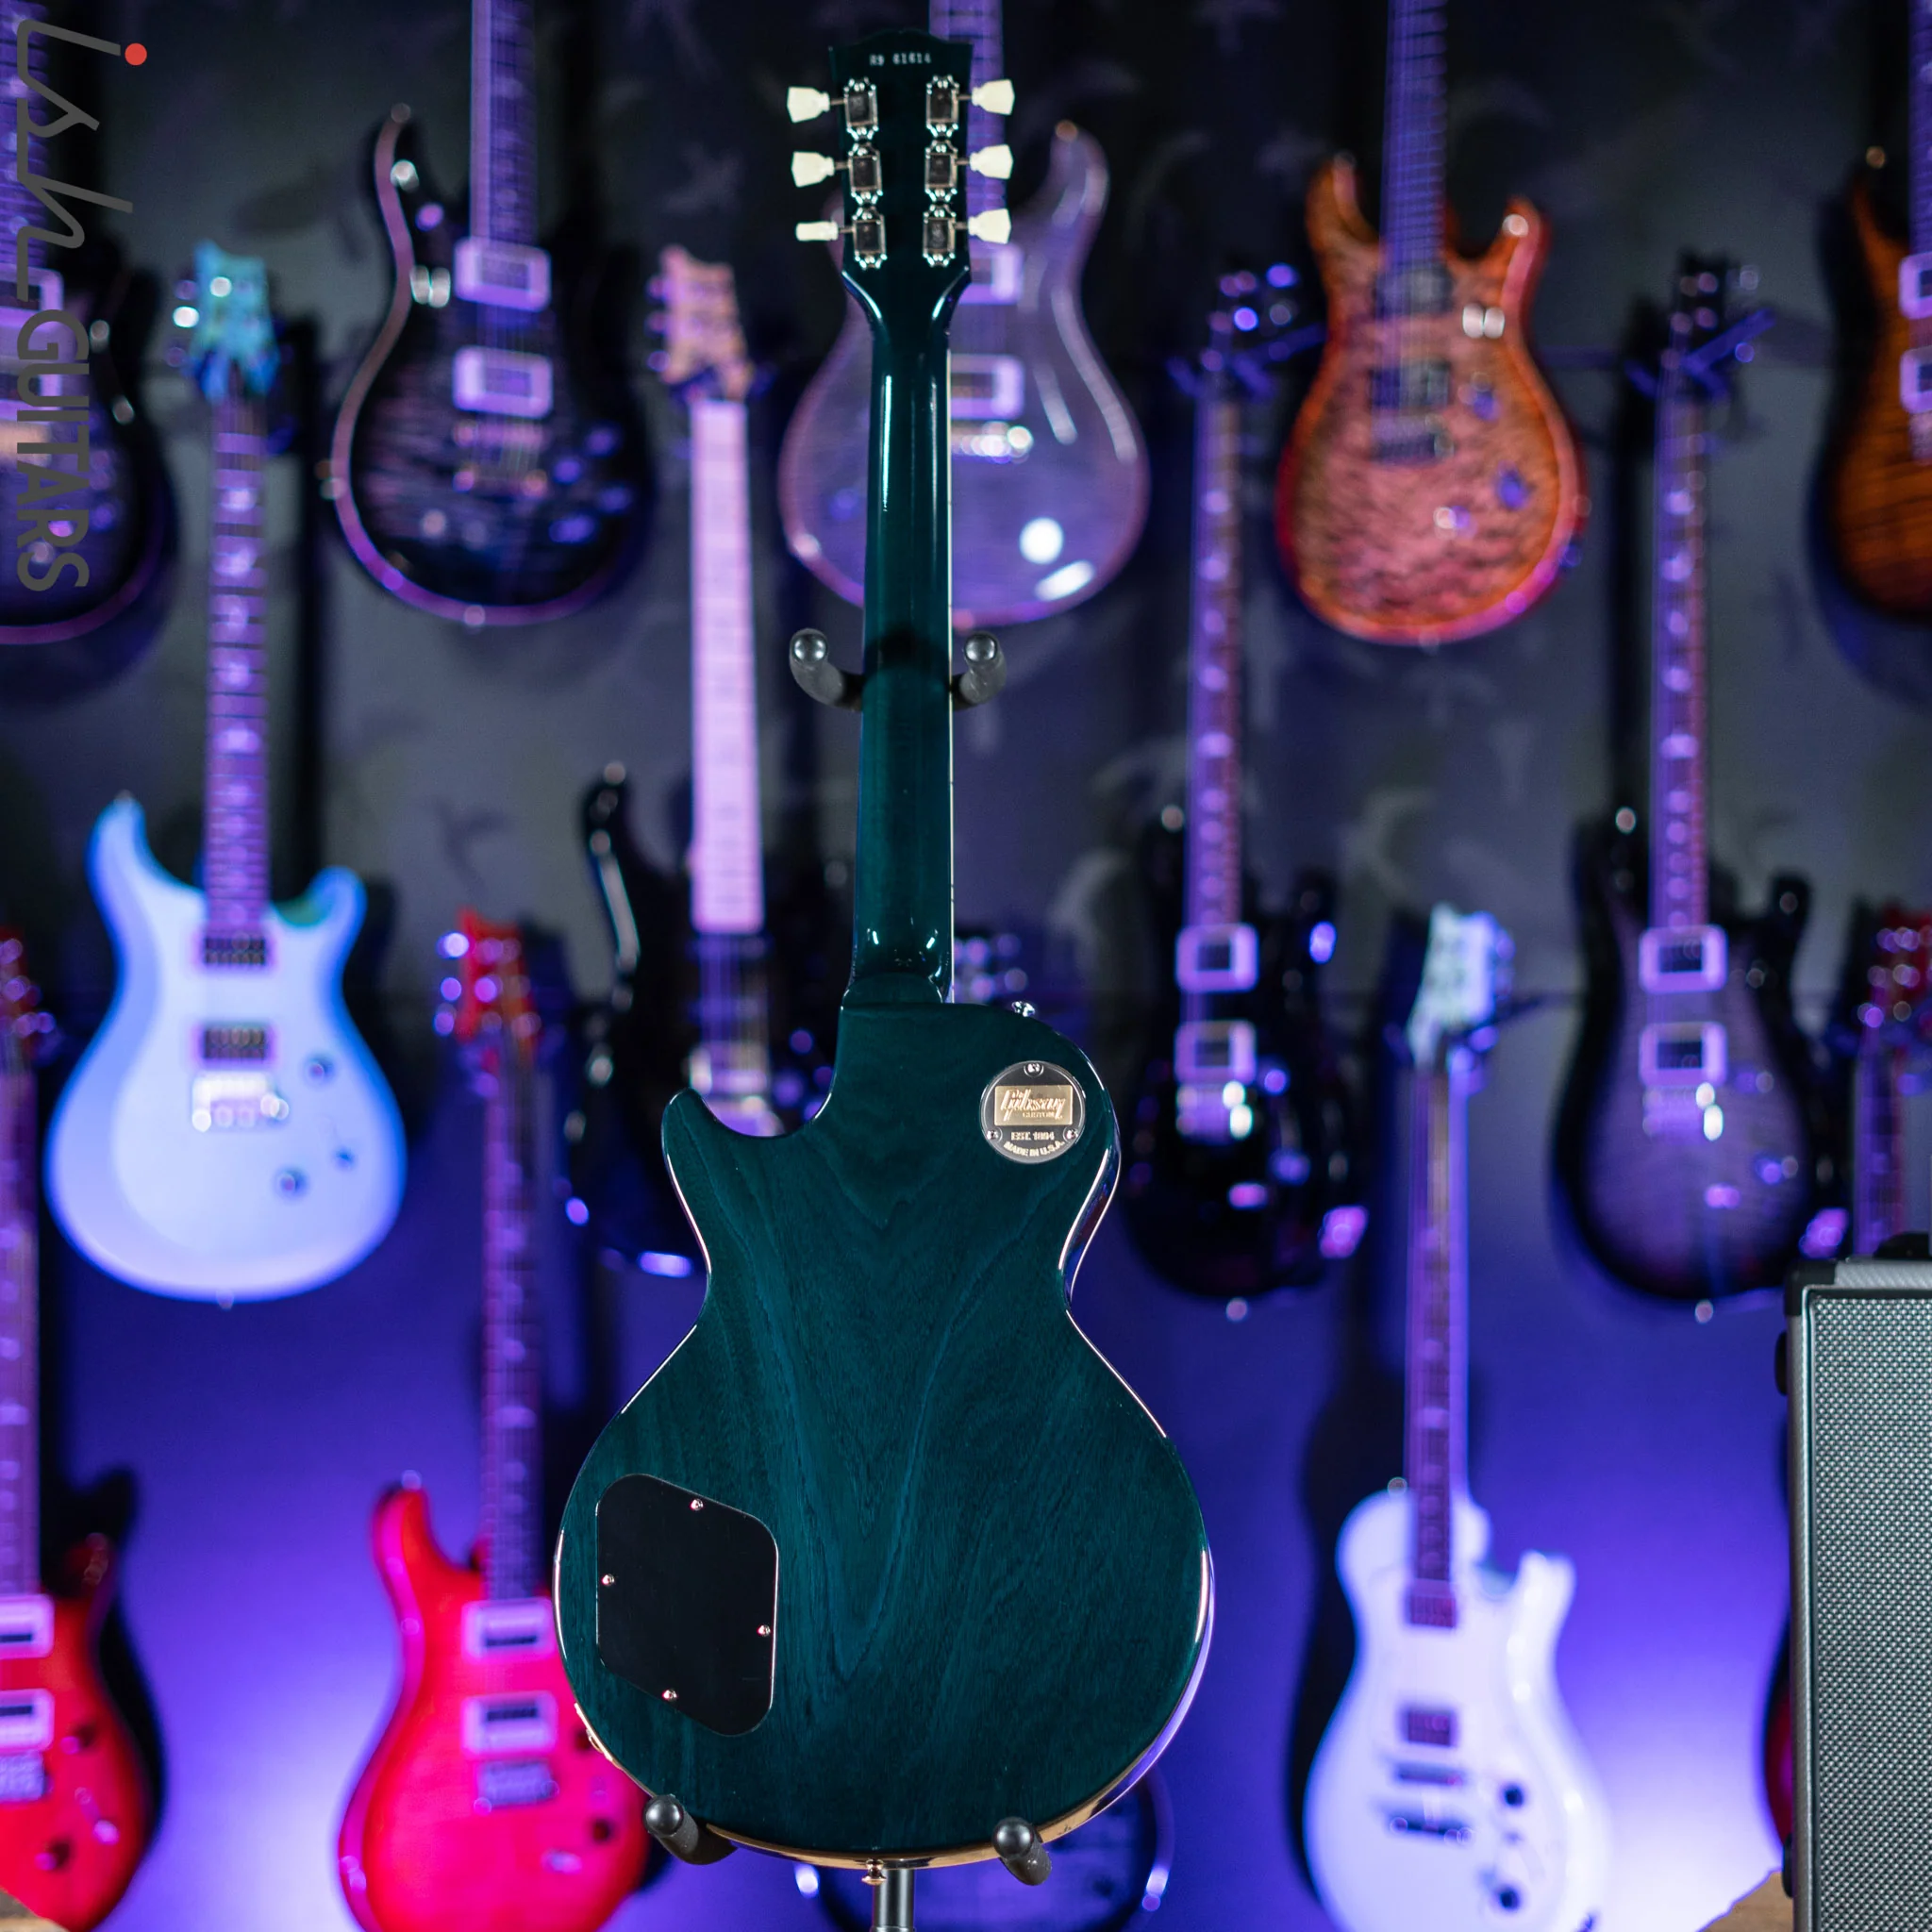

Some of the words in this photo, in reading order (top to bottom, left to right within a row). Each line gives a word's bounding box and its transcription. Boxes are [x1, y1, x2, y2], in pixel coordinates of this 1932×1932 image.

[870, 53, 885, 66] R9
[1000, 1089, 1066, 1121] Gibson
[1010, 1131, 1031, 1141] EST.
[1032, 1131, 1055, 1141] 1894
[1003, 1141, 1028, 1157] MADE
[1029, 1148, 1040, 1157] IN
